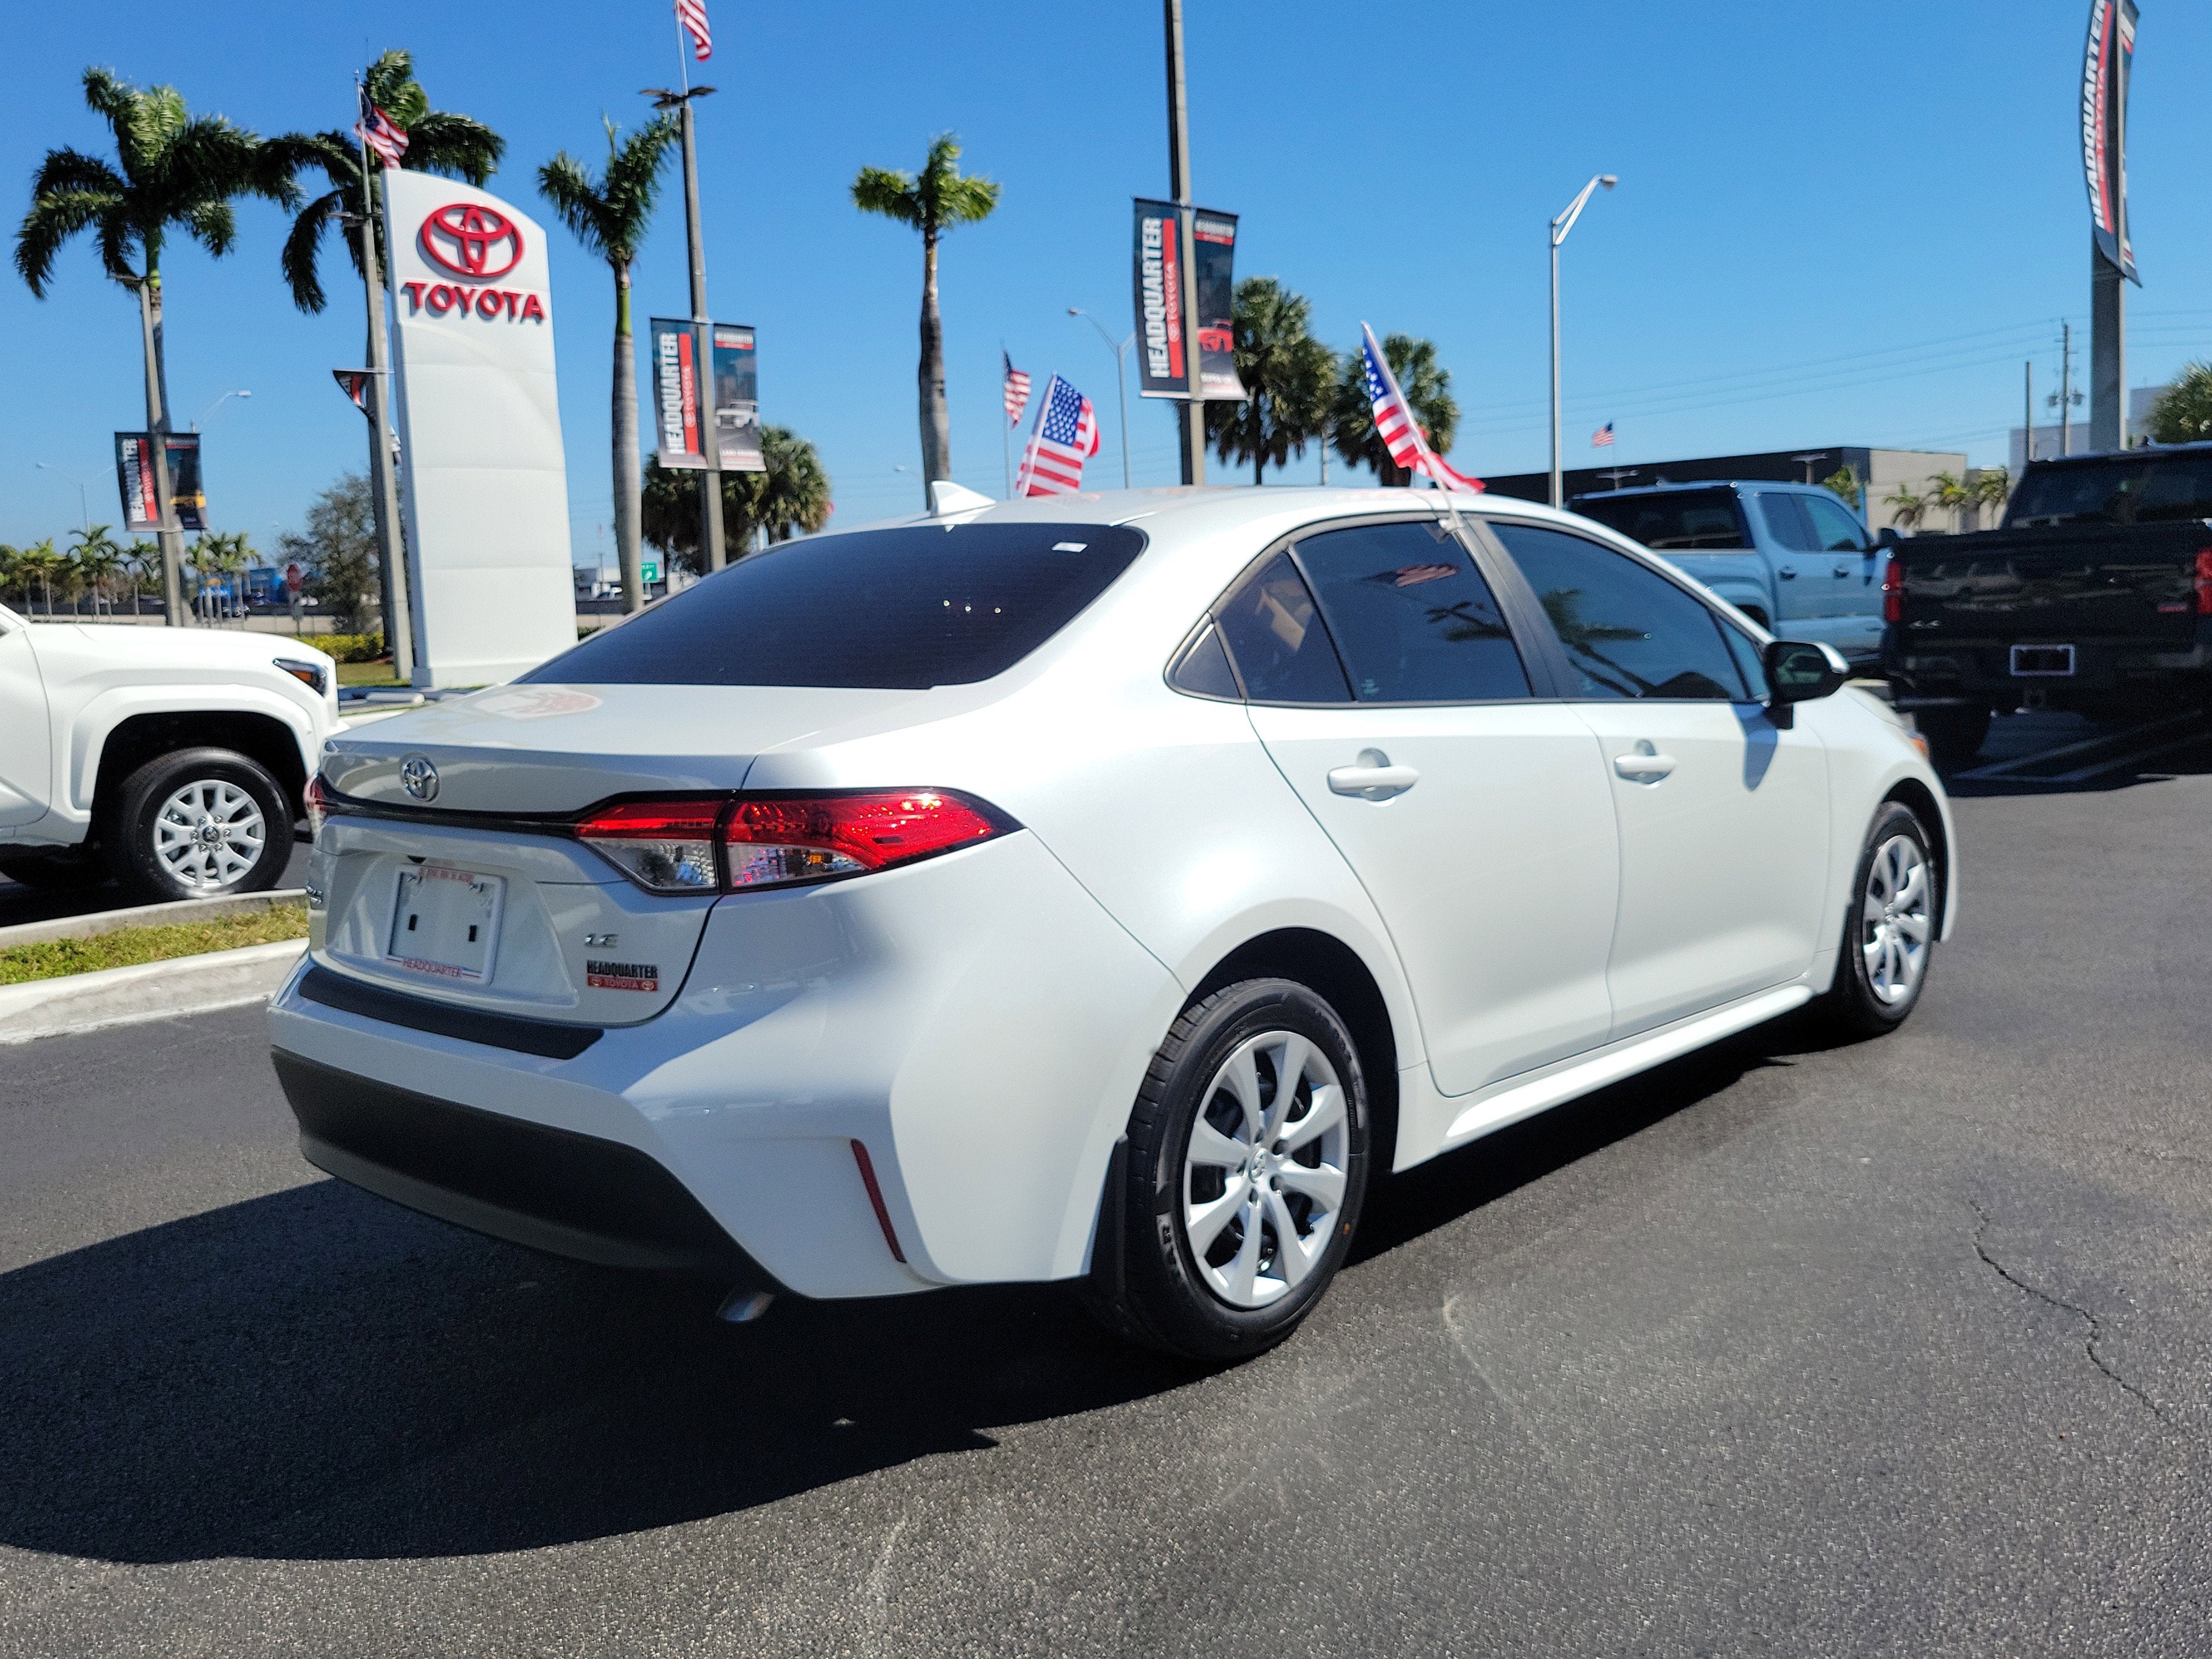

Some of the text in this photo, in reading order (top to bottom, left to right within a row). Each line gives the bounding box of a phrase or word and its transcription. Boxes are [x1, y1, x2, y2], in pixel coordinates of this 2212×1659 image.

[405, 282, 545, 320] TOYOTA
[1142, 217, 1171, 377] HEADQUARTER
[1165, 262, 1178, 320] TOYOTA
[660, 332, 686, 455] HEADQUARTER
[587, 960, 658, 978] HEADQUARTER
